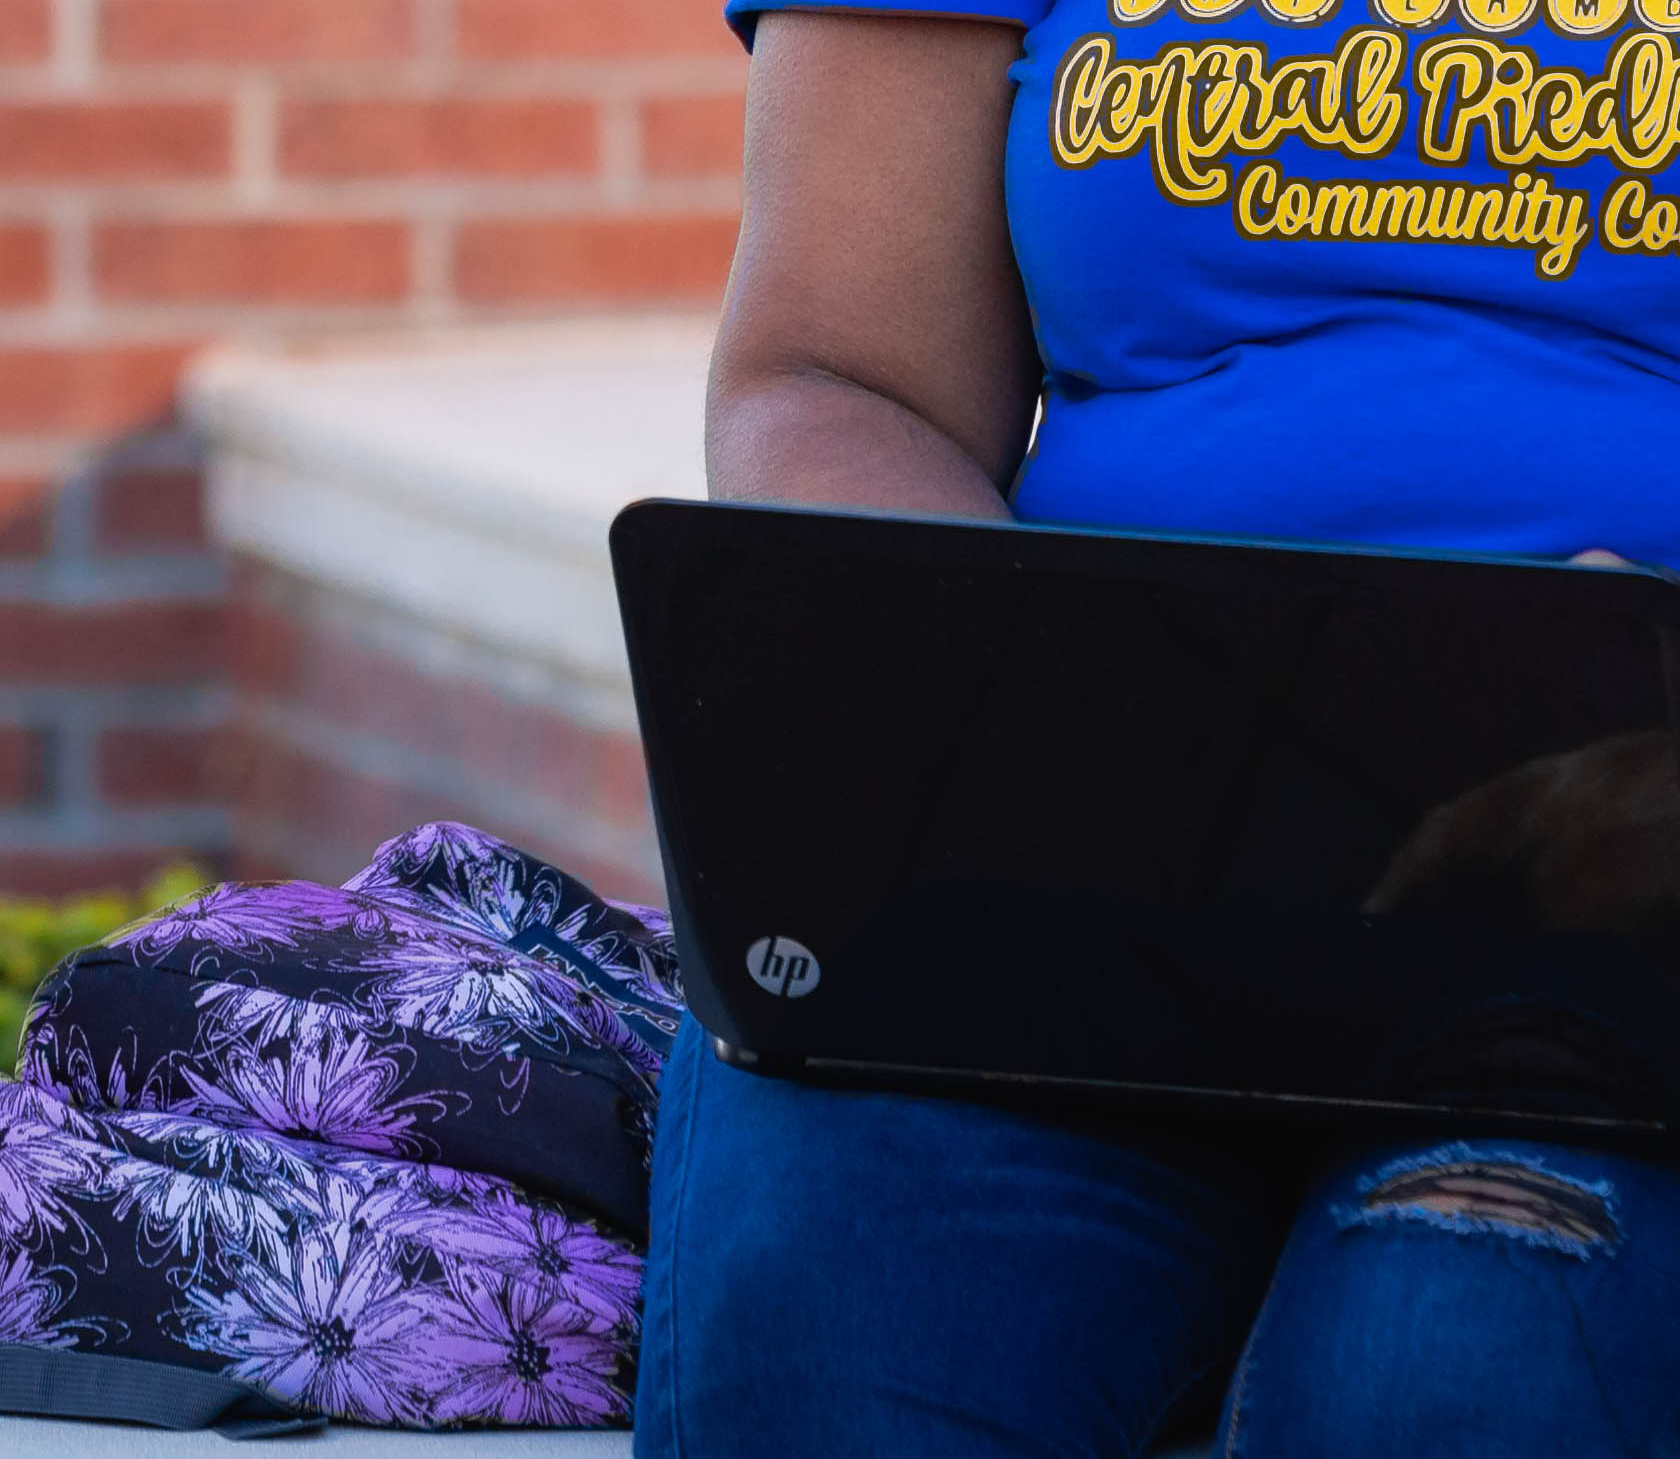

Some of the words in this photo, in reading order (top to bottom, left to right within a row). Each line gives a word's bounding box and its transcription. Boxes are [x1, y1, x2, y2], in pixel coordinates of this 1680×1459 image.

[1058, 31, 1404, 200] Central
[1240, 165, 1588, 278] Community
[759, 937, 811, 997] hp
